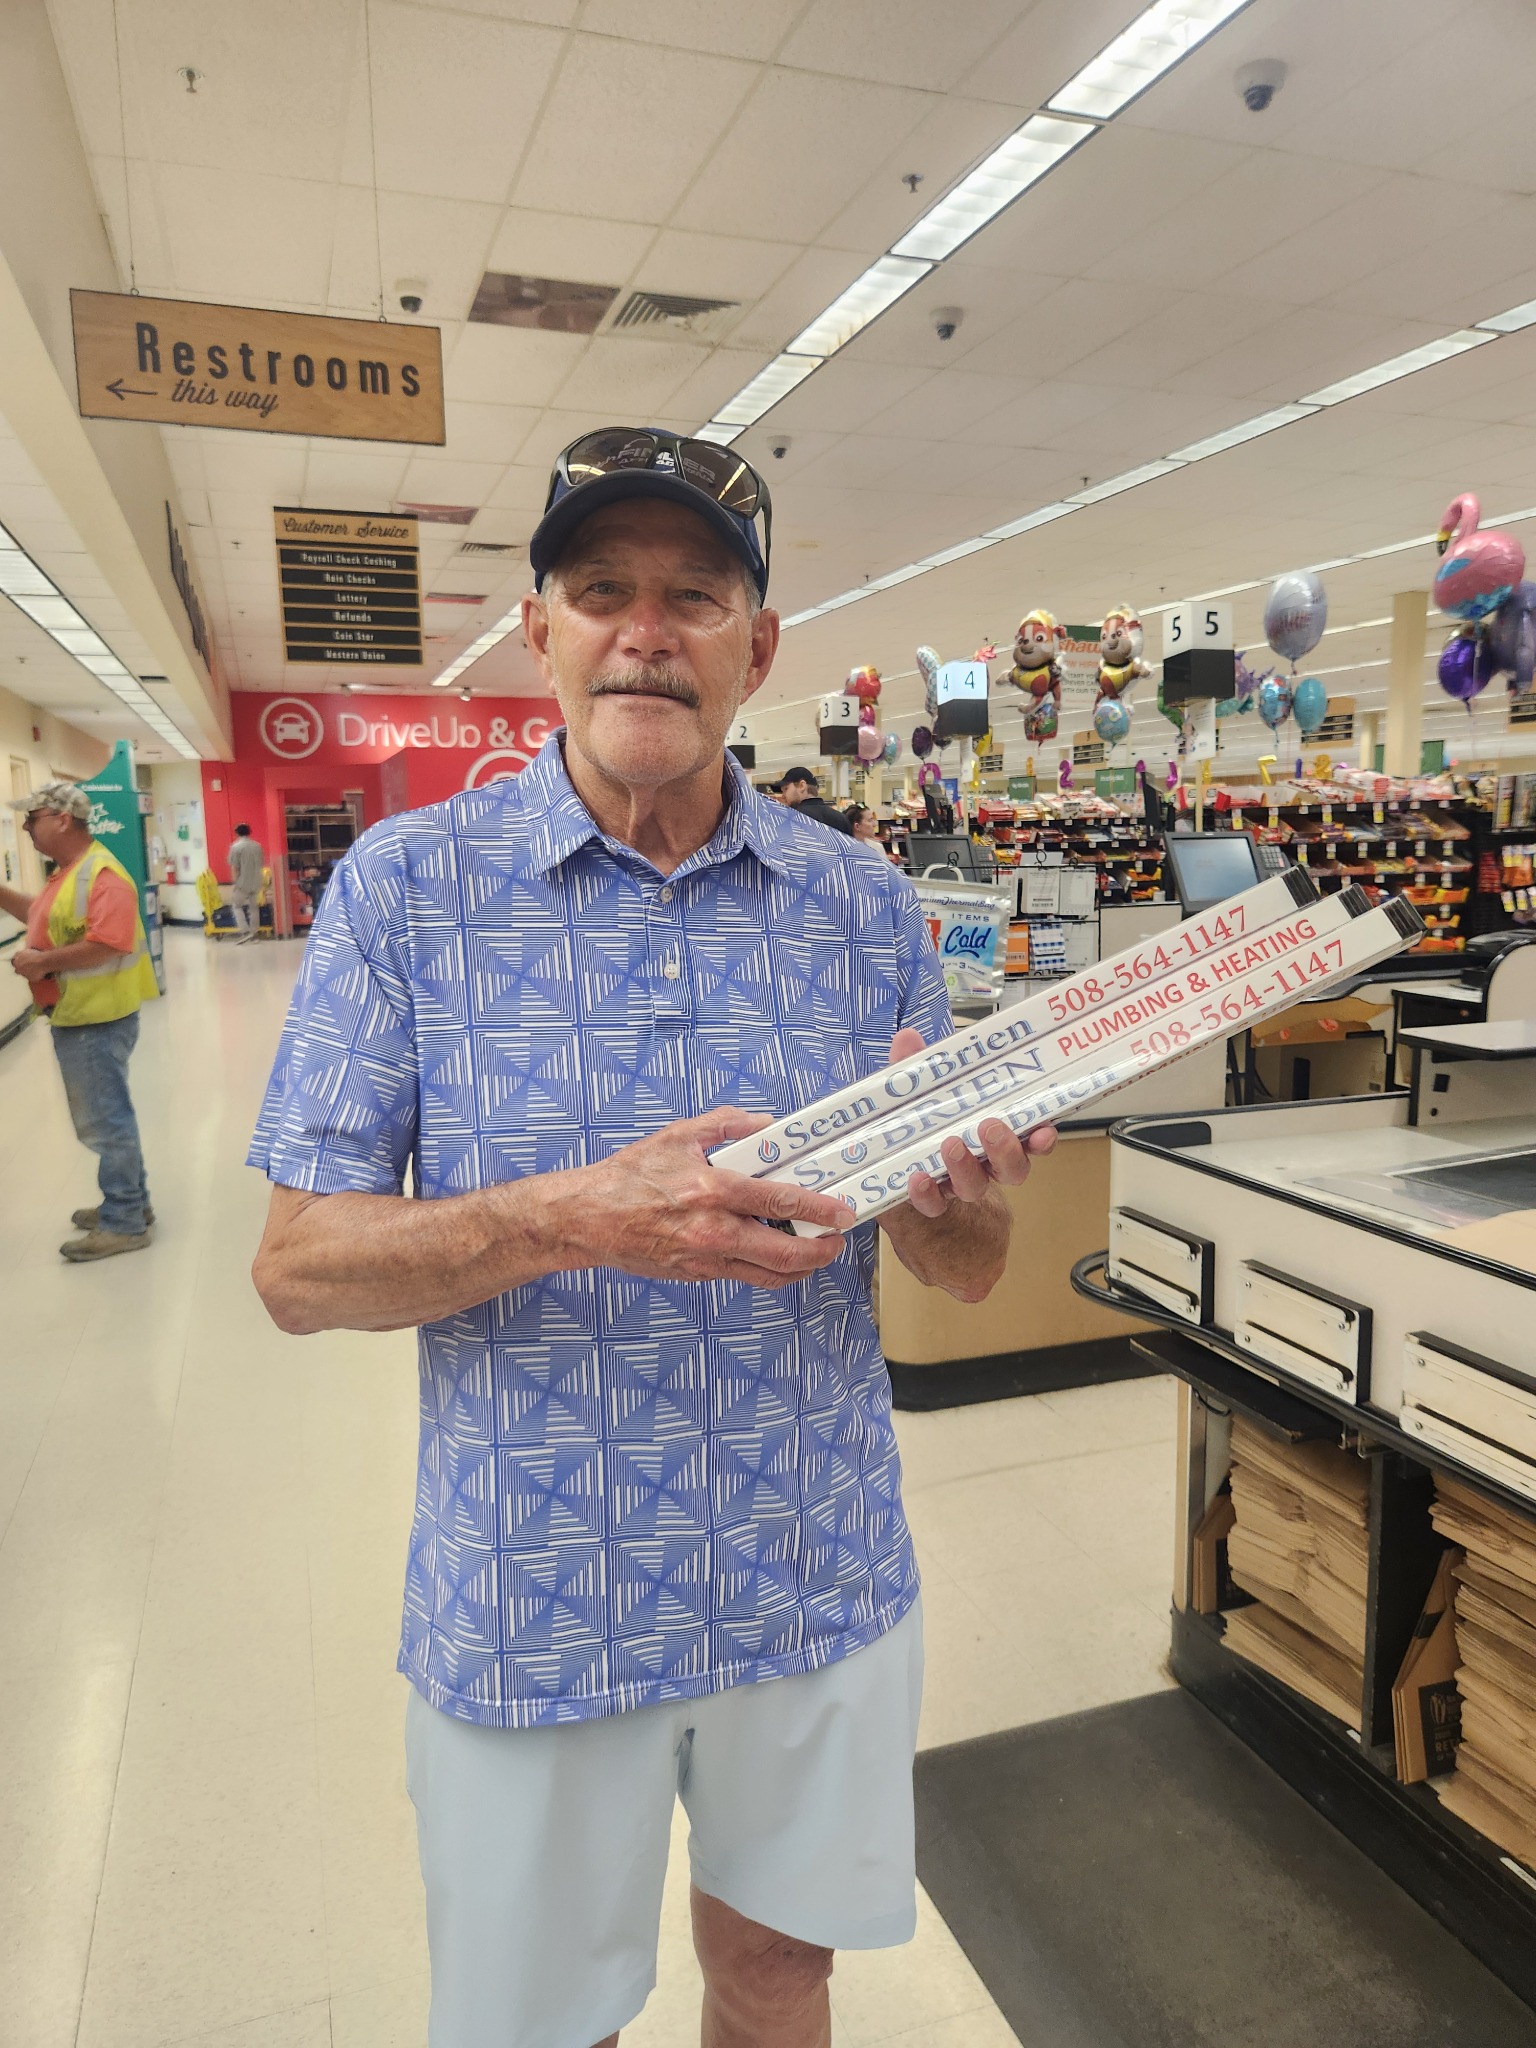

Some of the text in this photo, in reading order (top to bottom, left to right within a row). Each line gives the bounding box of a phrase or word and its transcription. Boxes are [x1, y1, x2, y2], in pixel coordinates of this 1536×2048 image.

[135, 321, 421, 397] Restrooms
[172, 378, 279, 419] this way
[283, 517, 409, 539] Customer Service
[302, 552, 397, 568] Payroll Check Cashing
[347, 574, 376, 585] Checks
[336, 593, 368, 605] Lottery
[332, 611, 372, 623] Refunds
[1205, 611, 1219, 637] 5
[334, 631, 374, 641] Coin Star
[1172, 615, 1182, 643] 5
[324, 649, 386, 661] Western Union
[943, 673, 948, 692] 4
[964, 670, 975, 689] 4
[824, 702, 829, 718] 3
[841, 702, 851, 717] 3
[337, 712, 482, 748] DriveUp
[487, 715, 516, 749] &
[740, 725, 747, 738] 2
[952, 913, 990, 922] ITEMS
[1129, 939, 1344, 1068] 508-564-1147
[784, 905, 1247, 1150] Sean O'Brien 508-564-1147
[793, 1159, 836, 1188] S.
[1057, 983, 1185, 1057] PLUMBING
[1186, 972, 1211, 994] &
[1210, 919, 1317, 982] HEATING
